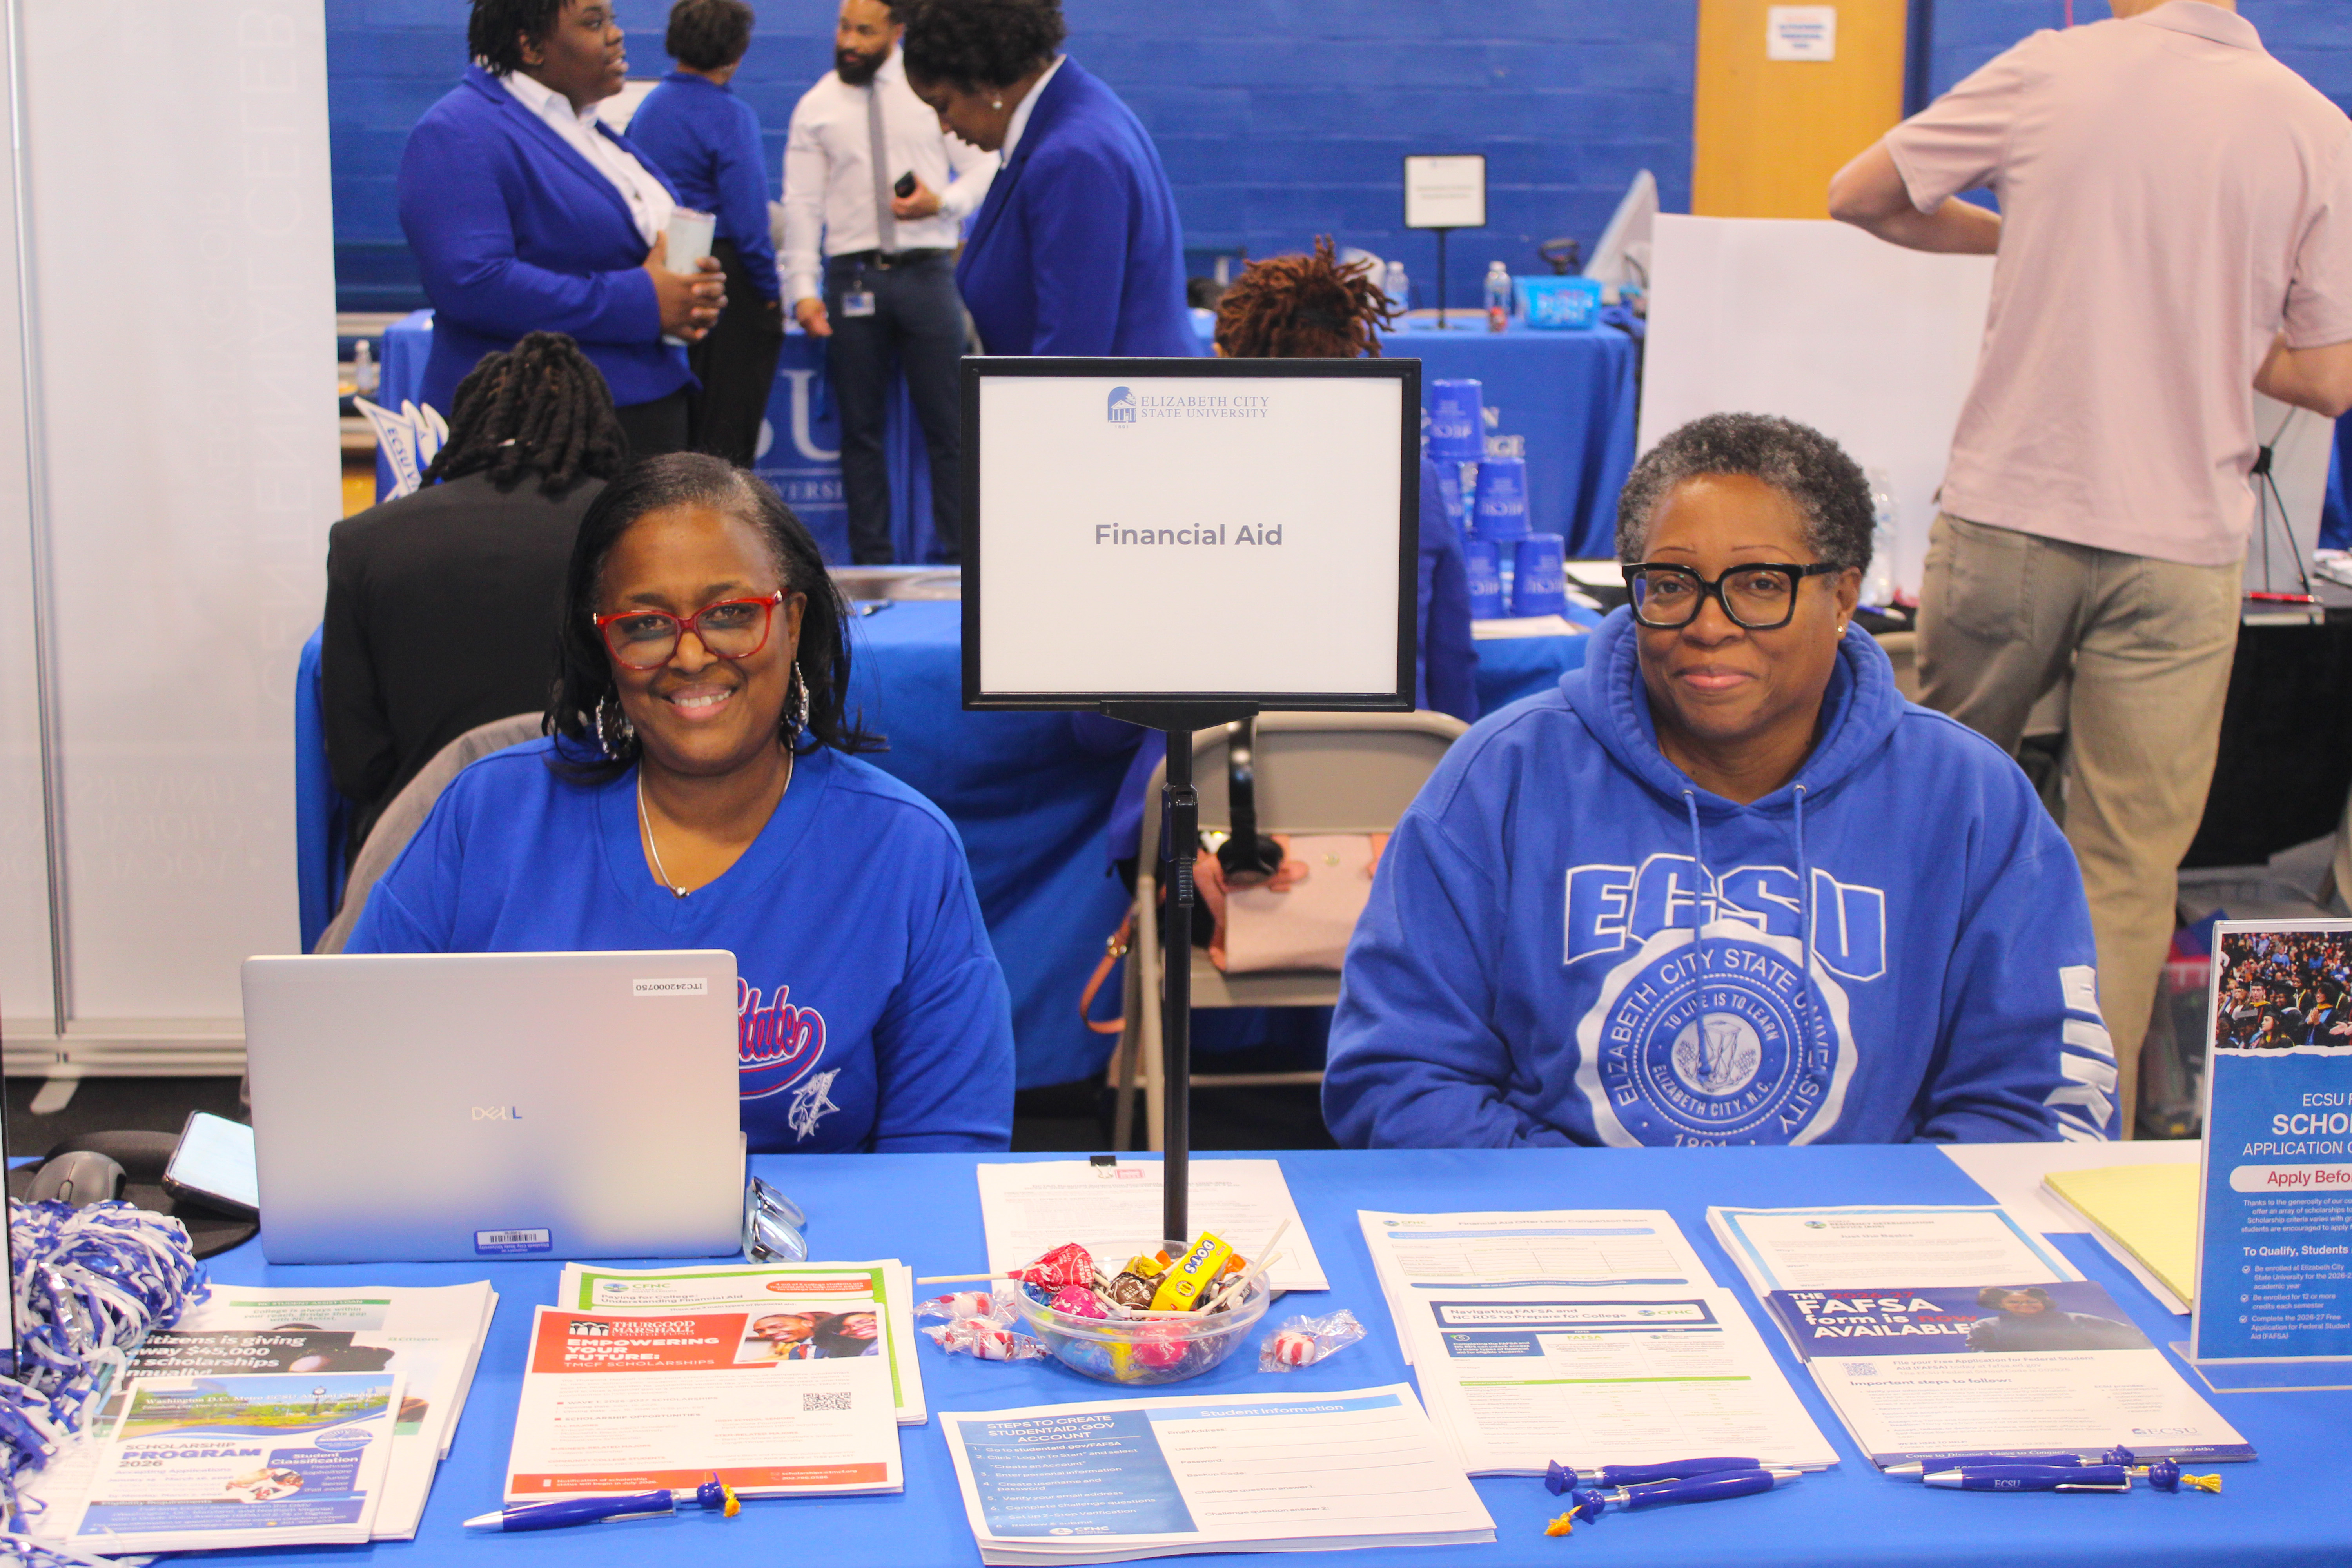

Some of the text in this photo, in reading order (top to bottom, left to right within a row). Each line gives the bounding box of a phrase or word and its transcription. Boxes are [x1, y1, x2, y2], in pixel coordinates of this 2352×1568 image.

[1141, 397, 1270, 407] ELIZABETH CITY
[1141, 409, 1268, 417] STATE UNIVERSITY
[1096, 523, 1282, 545] Financial Aid
[1563, 853, 1886, 981] ECSU
[1664, 1018, 1682, 1030] TO
[1713, 992, 1726, 1006] IS
[1731, 993, 1747, 1008] TO
[1746, 1001, 1780, 1041] LEARN
[1607, 982, 1658, 1106] ELIZABETH
[1660, 949, 1714, 984] CITY
[1724, 948, 1797, 992] STATE
[1652, 1063, 1706, 1115] ELIZABETH
[1710, 1099, 1748, 1116] CITY,
[2303, 1093, 2344, 1107] ECSU
[472, 1106, 522, 1120] DELL
[2272, 1113, 2352, 1135] SCHO
[2243, 1141, 2343, 1155] APPLICATION
[2267, 1171, 2311, 1187] Apply
[2288, 1198, 2322, 1207] generosity
[1184, 1240, 1216, 1274] DOTS
[2243, 1245, 2348, 1257] To Qualify, Students
[1795, 1298, 1944, 1314] FAFSA
[1806, 1314, 1877, 1325] form
[1882, 1313, 1909, 1323] is
[147, 1334, 307, 1348] itizens is giving
[568, 1338, 719, 1346] EMPOWERING
[187, 1345, 270, 1356] $45,000
[144, 1357, 280, 1368] scholarships
[1201, 1405, 1344, 1417] Student Information
[987, 1422, 1031, 1430] STEPS
[1056, 1415, 1112, 1424] CREATE
[988, 1422, 1115, 1436] STUDENTAID.GOV
[1018, 1432, 1091, 1443] ACCOUNT
[1013, 1441, 1122, 1452] studentaid.gov/FAFSA
[122, 1449, 262, 1460] PROGRAM
[270, 1457, 358, 1465] Classification
[1994, 1479, 2021, 1488] ECSU
